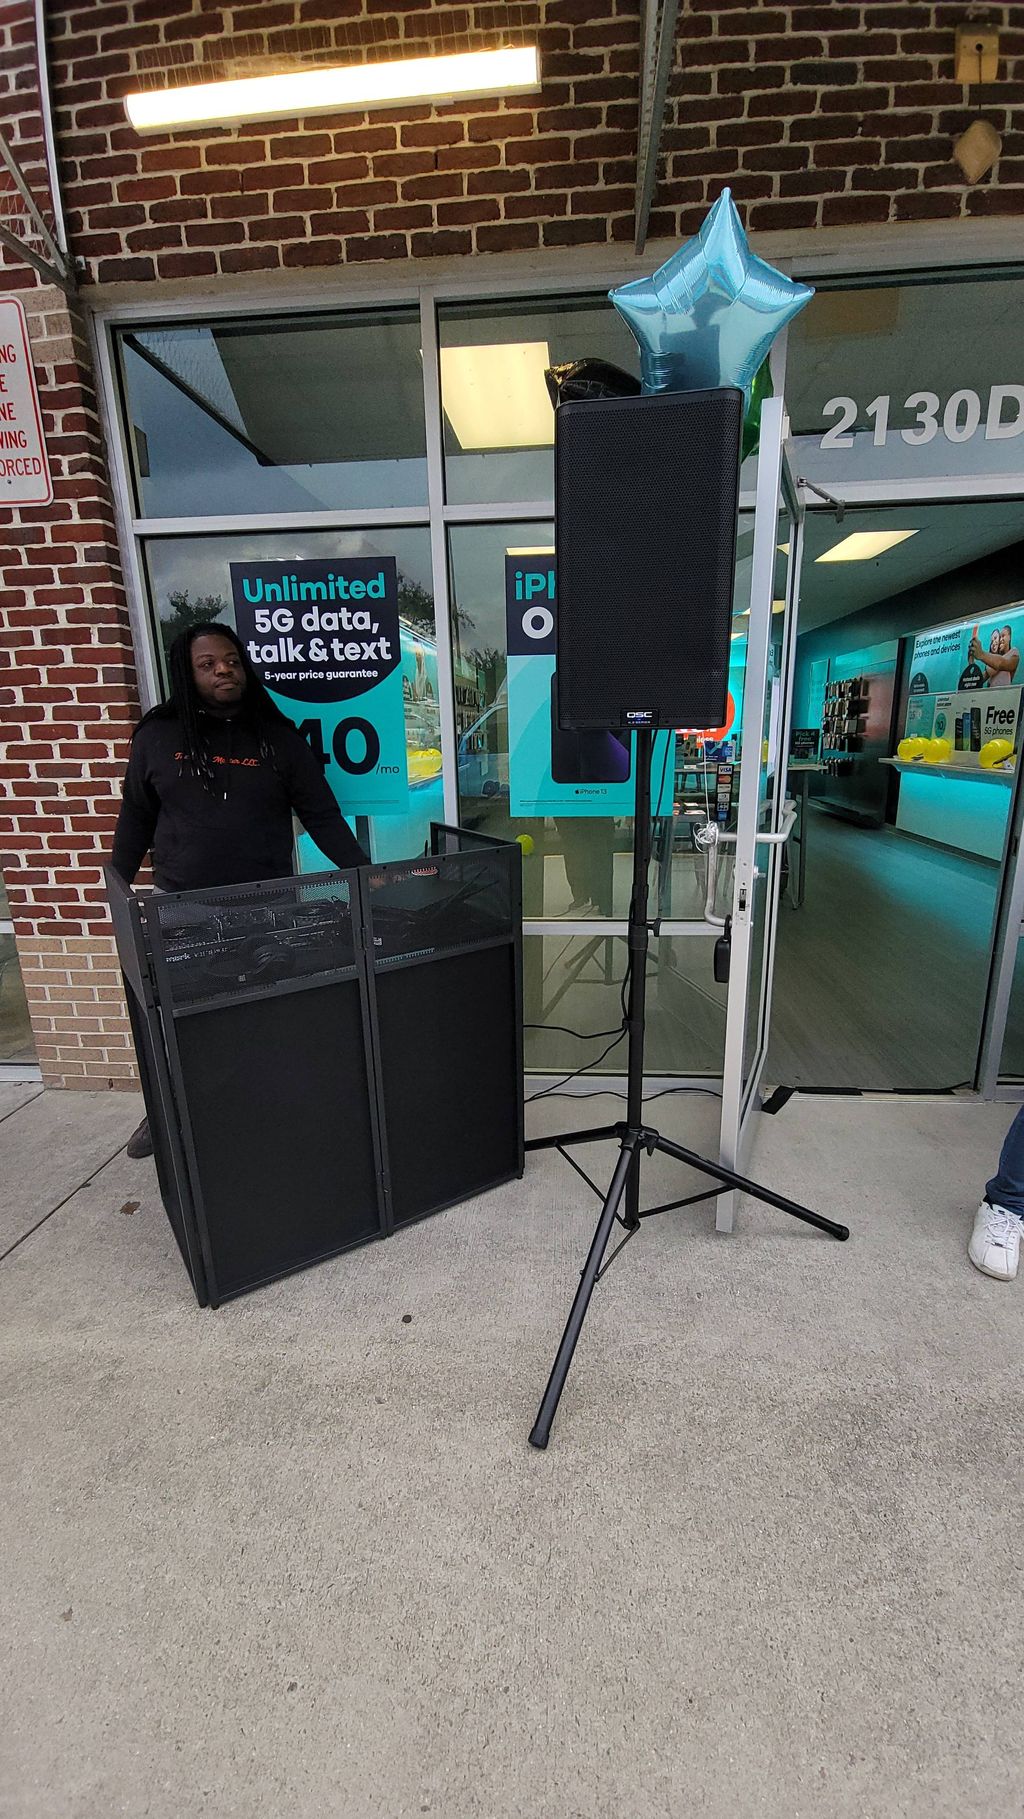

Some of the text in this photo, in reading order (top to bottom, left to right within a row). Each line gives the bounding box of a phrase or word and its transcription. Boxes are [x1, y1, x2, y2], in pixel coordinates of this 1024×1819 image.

[819, 384, 1024, 449] 2130D
[242, 572, 386, 602] Unlimited
[254, 605, 380, 634] 5G data,
[521, 606, 554, 640] O
[247, 636, 393, 664] talk & text
[915, 630, 961, 649] Explore the newest
[914, 643, 961, 661] phones and devices
[264, 669, 379, 682] 5-year price guarantee
[626, 711, 653, 719] QSC
[986, 705, 1015, 724] Free
[984, 726, 1014, 737] 5G phones
[296, 716, 400, 776] 40 /mo
